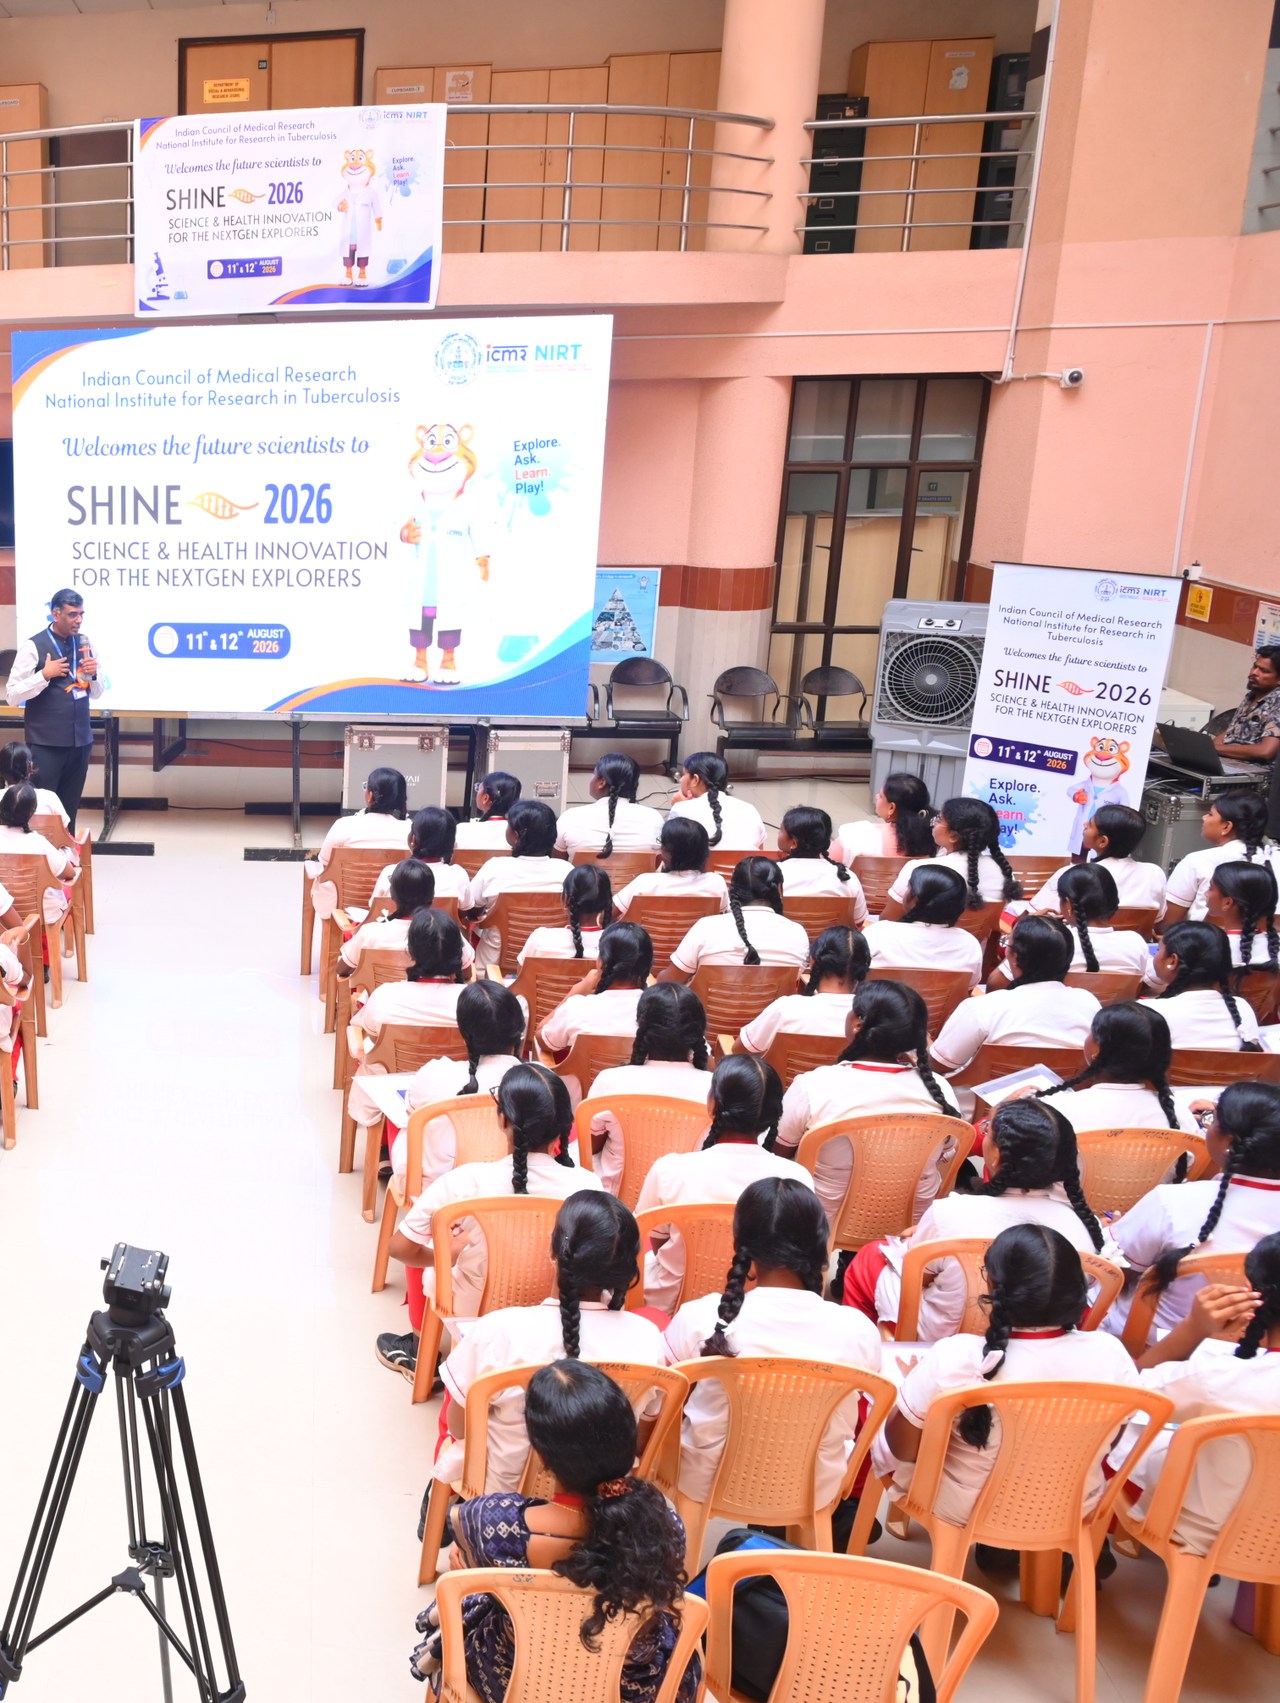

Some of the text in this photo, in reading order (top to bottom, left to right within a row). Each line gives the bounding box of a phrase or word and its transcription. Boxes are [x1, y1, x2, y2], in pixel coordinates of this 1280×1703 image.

[175, 120, 315, 137] Indian Council of Medical Research
[156, 132, 336, 150] National Institute for Research in Tuberculosis
[164, 156, 322, 174] Welcomes the future scientists to
[166, 182, 304, 210] SHINE 2026
[168, 211, 332, 229] SCIENCE & HEALTH INNOVATION
[169, 226, 318, 243] FOR THE NEXTGEN EXPLORERS
[534, 344, 582, 361] NIRT
[82, 365, 357, 386] Indian Council of Medical Research
[46, 387, 400, 408] National Institute for Research in Tuberculosis
[62, 434, 371, 464] Welcomes the future scientists to
[514, 438, 561, 453] Explore.
[514, 452, 540, 466] Ask.
[515, 468, 551, 480] Learn.
[515, 480, 544, 495] Play!
[67, 483, 332, 526] SHINE 2026
[72, 541, 388, 561] SCIENCE & HEALTH INNOVATION
[73, 568, 361, 587] FOR THE NEXTGEN EXPLORERS
[1143, 589, 1167, 597] NIRT
[999, 604, 1162, 629] Indian Council of Medical Research
[247, 628, 285, 638] AUGUST
[1003, 616, 1155, 640] National Institute for Research in
[210, 639, 217, 650] &
[253, 640, 279, 653] 2026
[1048, 632, 1103, 646] Tuberculosis
[1004, 647, 1147, 673] Welcomes the future scientists to
[993, 669, 1152, 707] SHINE 2026
[990, 693, 1144, 724] SCIENCE & HEALTH INNOVATION
[995, 705, 1137, 735] FOR THE NEXTGEN EXPLORERS
[1015, 752, 1021, 760] &
[1044, 750, 1073, 761] AUGUST
[1046, 759, 1067, 770] 2026
[990, 778, 1040, 793] Explore.
[988, 793, 1016, 805] Ask.
[996, 810, 1027, 821] earn.
[1000, 824, 1018, 836] ay!
